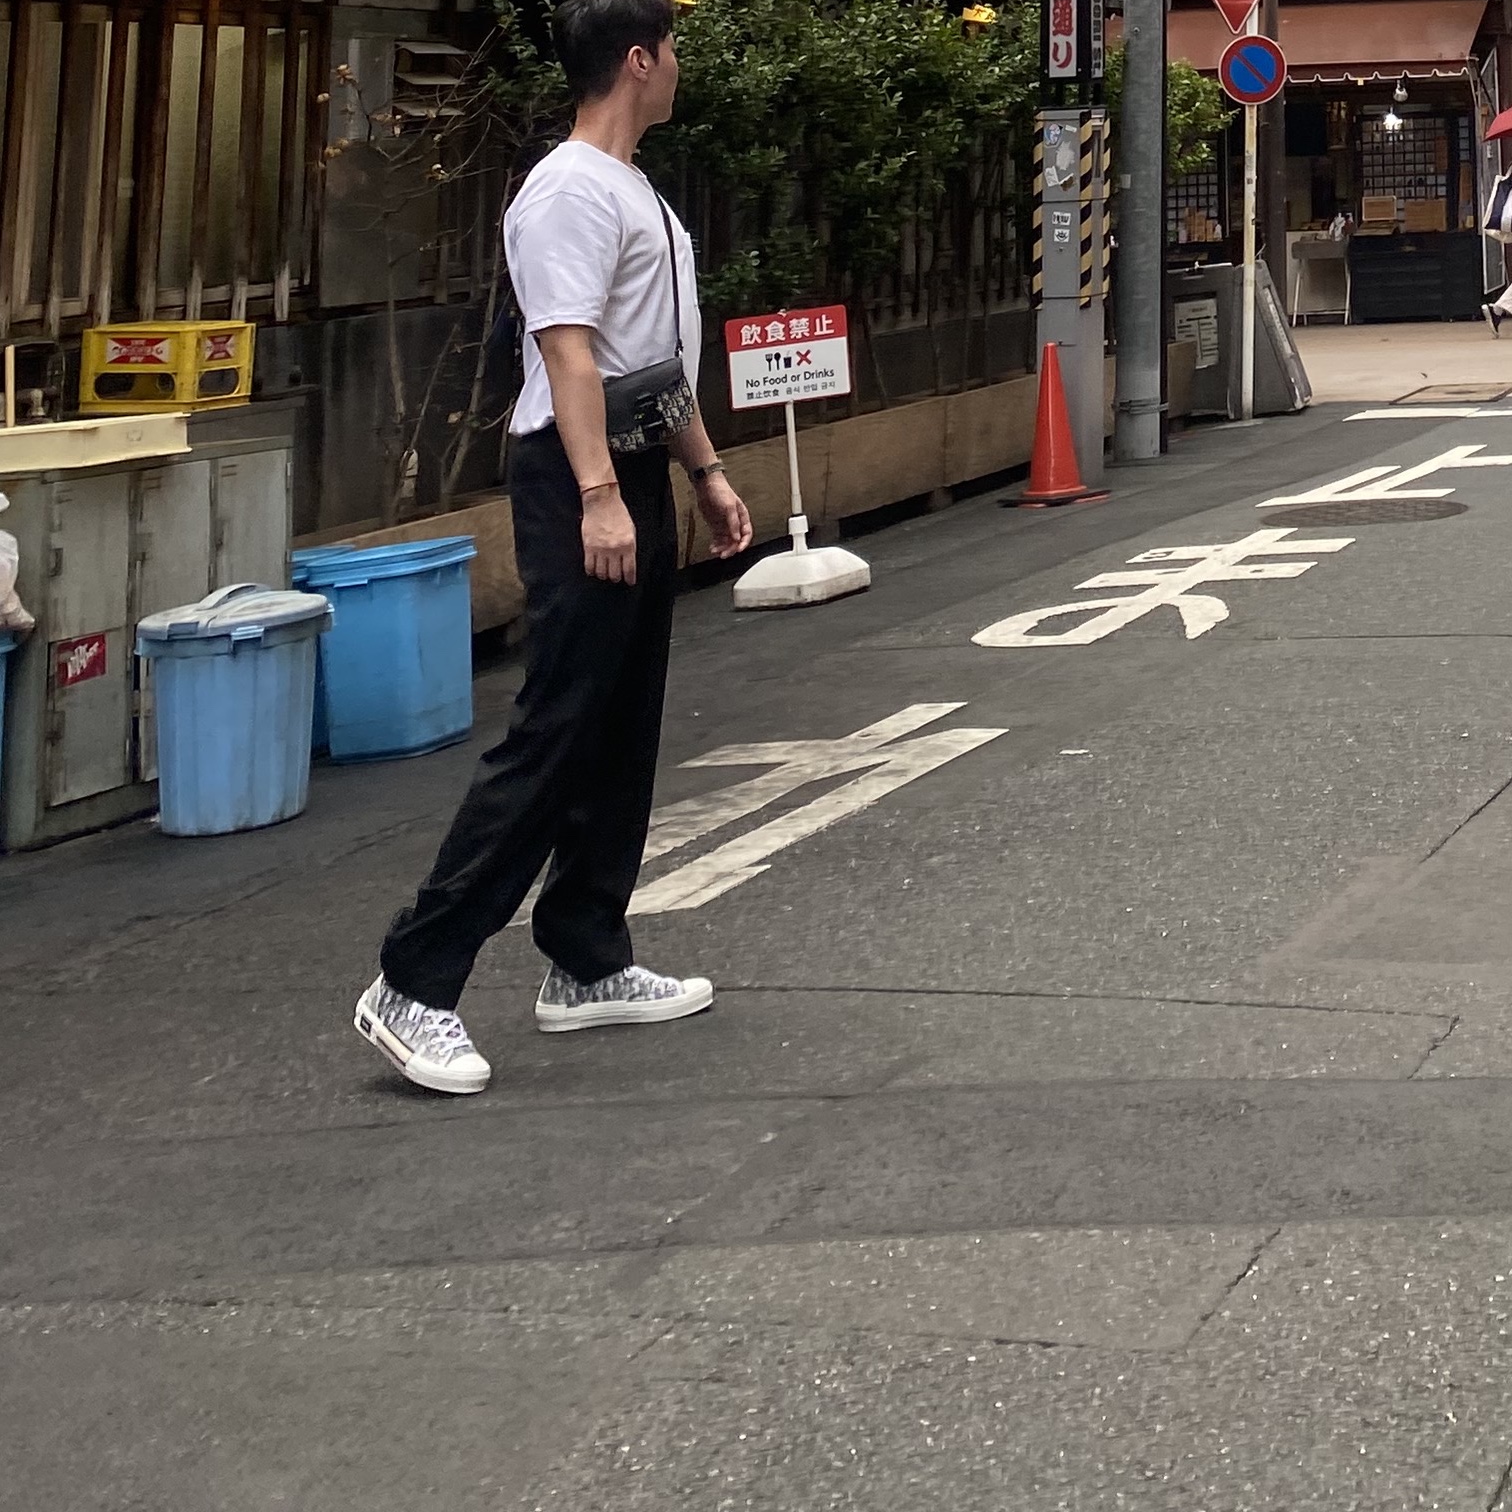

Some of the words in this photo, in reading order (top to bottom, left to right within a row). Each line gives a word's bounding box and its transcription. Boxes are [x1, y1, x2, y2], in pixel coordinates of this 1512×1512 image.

[740, 314, 835, 346] 飲食禁止
[746, 379, 761, 388] No
[763, 374, 788, 386] Food
[791, 374, 801, 382] or
[804, 368, 834, 380] Drinks
